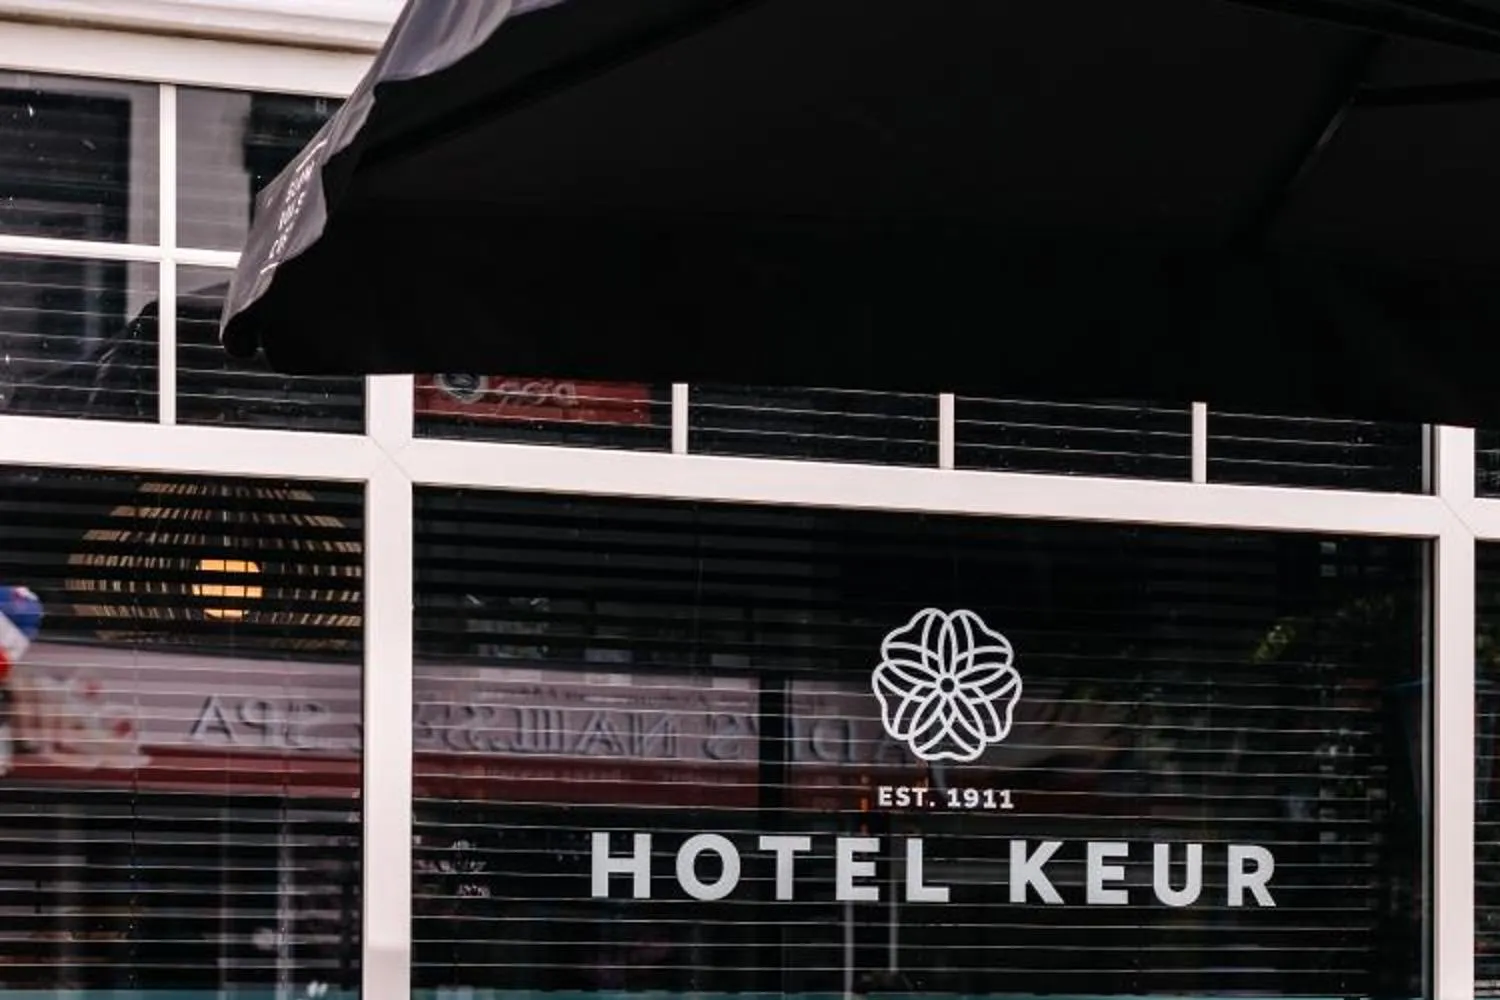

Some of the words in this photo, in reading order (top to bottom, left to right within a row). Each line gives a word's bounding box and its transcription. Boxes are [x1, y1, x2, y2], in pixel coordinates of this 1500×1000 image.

[878, 786, 936, 809] EST.
[946, 787, 1016, 810] 1911
[590, 831, 951, 903] HOTEL
[1008, 839, 1277, 908] KEUR
